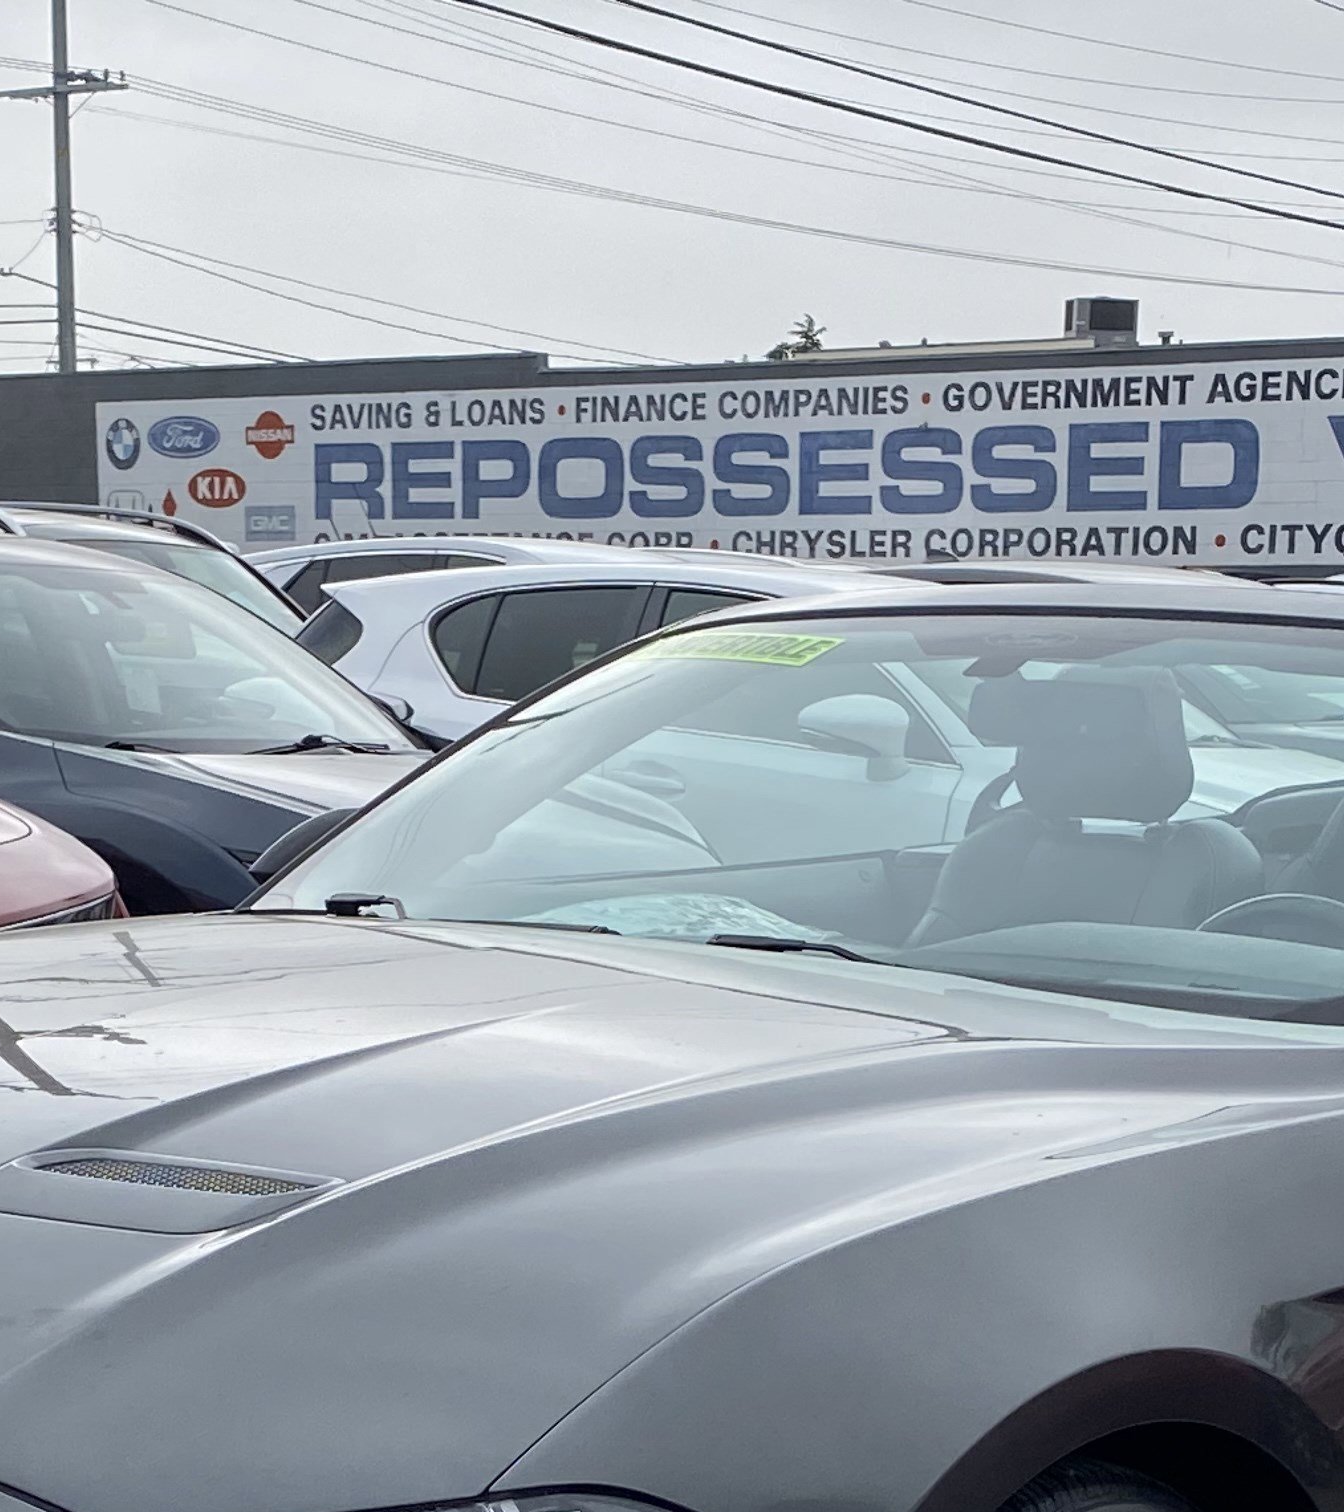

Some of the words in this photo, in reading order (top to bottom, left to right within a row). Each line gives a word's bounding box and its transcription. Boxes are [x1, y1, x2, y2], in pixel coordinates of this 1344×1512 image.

[311, 402, 413, 430] SAVING
[425, 402, 440, 427] &
[450, 399, 546, 428] LOANS
[575, 392, 706, 424] FINANCE
[718, 385, 909, 420] COMPANIES
[943, 375, 1194, 413] GOVERNMENT
[163, 424, 204, 449] Ford
[248, 428, 293, 443] NISSAN
[314, 418, 1260, 520] REPOSSESSED
[196, 476, 240, 500] KIA
[250, 515, 289, 531] GMC
[732, 527, 912, 559] CHRYSLER
[925, 523, 1197, 559] CORPORATION
